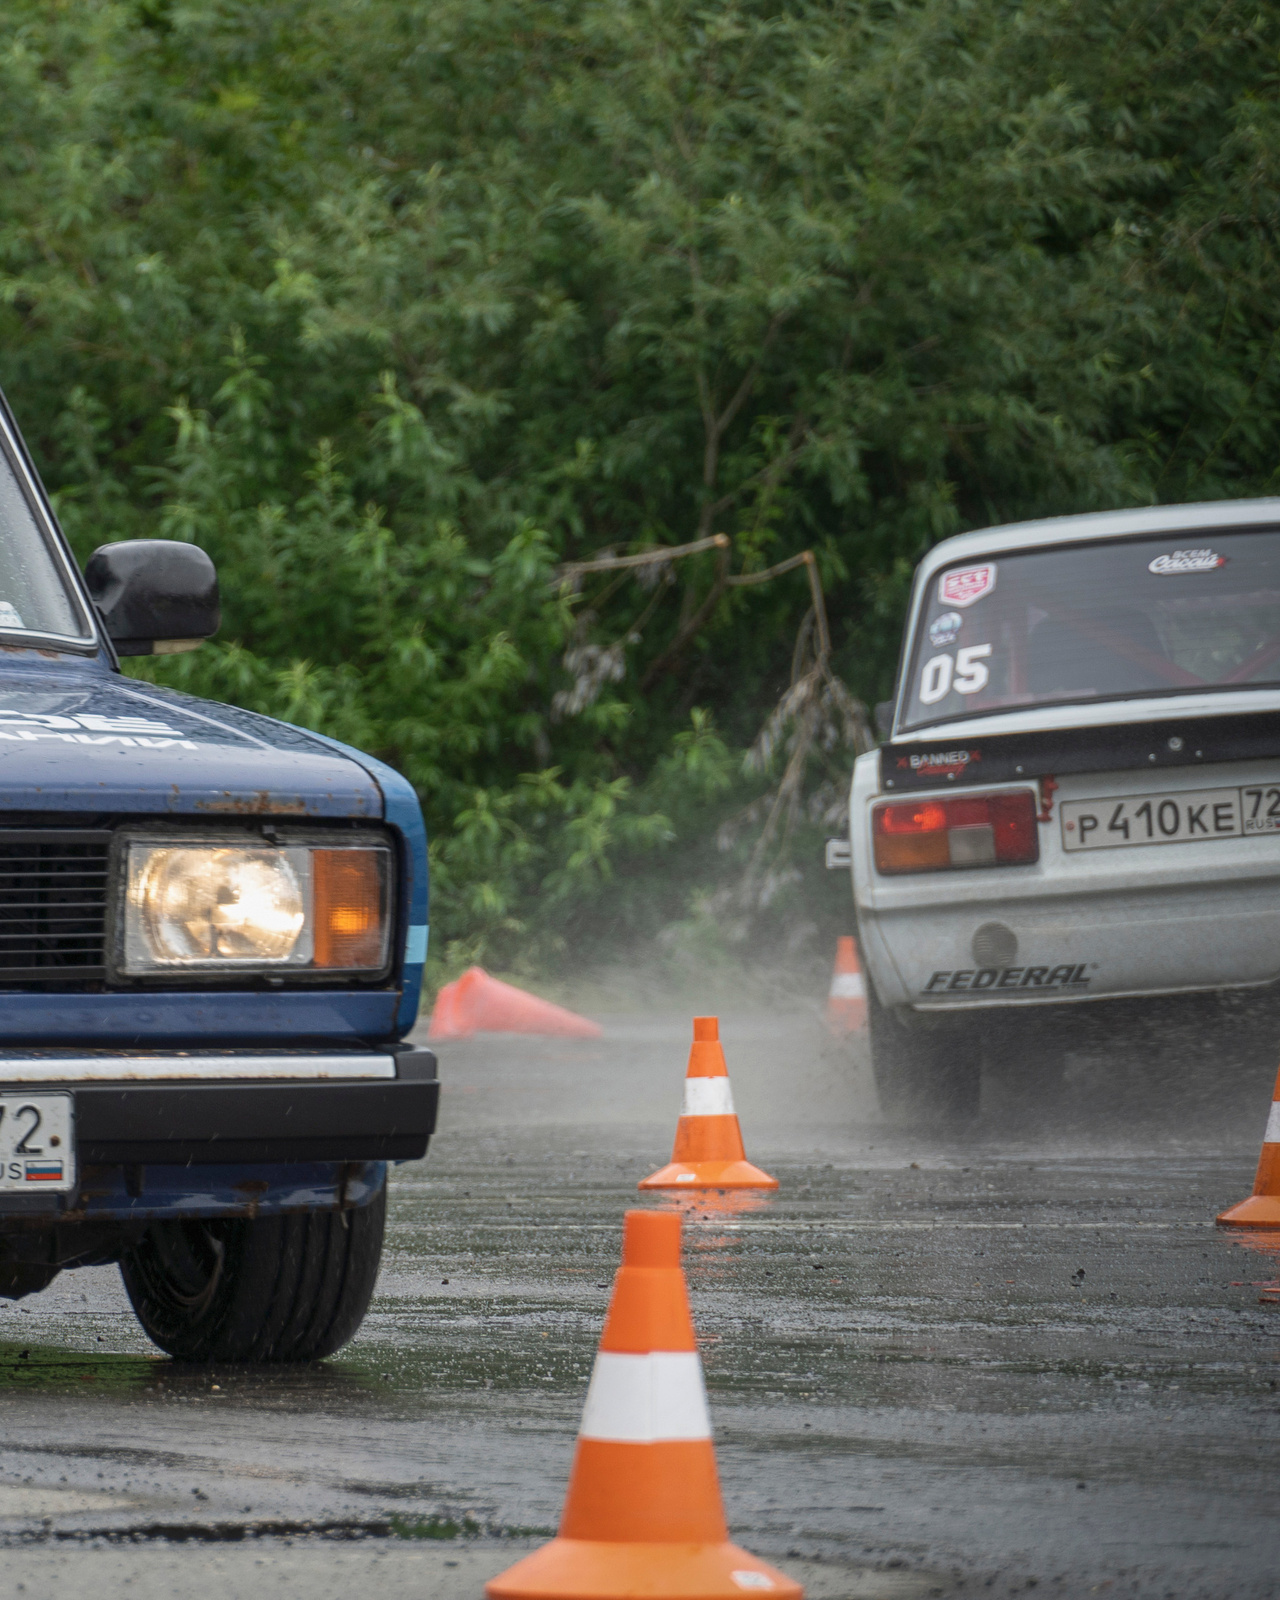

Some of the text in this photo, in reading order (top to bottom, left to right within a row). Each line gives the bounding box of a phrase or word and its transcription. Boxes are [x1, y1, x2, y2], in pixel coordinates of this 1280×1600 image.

[920, 643, 992, 705] 05
[909, 750, 971, 769] BANNED
[1245, 788, 1280, 820] 72
[1245, 818, 1274, 832] RUS
[924, 962, 1092, 990] FEDERAL
